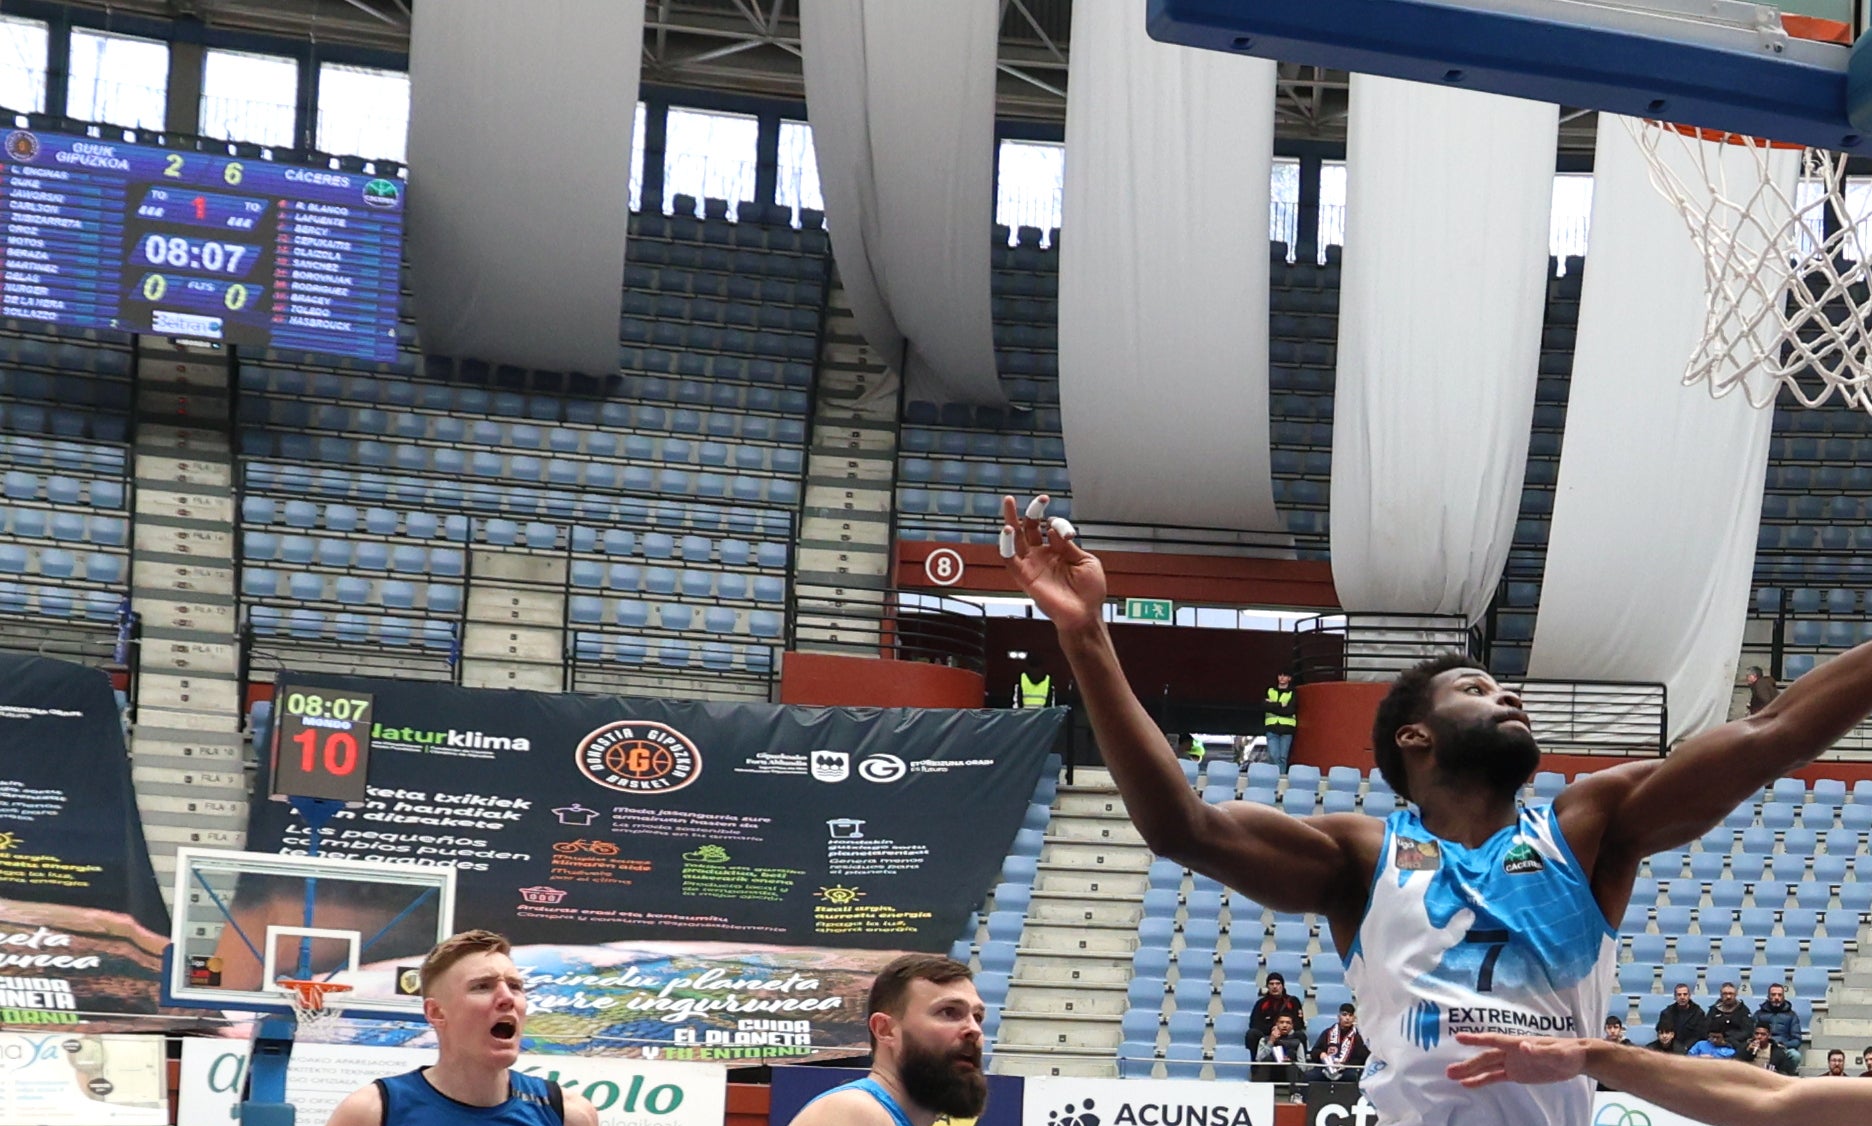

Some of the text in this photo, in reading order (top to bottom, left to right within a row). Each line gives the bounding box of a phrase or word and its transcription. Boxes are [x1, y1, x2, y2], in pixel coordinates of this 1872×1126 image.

[55, 151, 130, 171] GIPUZKOA
[163, 153, 244, 186] 2 6
[191, 195, 207, 219] 1
[145, 234, 246, 273] 08:07
[143, 274, 247, 311] 0 0
[936, 558, 952, 576] 8
[287, 692, 370, 722] 08:07
[293, 727, 360, 776] 10
[586, 727, 634, 772] DONOSTIA
[605, 774, 671, 789] BASKET
[393, 801, 522, 821] handiak
[433, 788, 532, 811] txikiek
[363, 811, 504, 830] ditzakete
[341, 829, 489, 848] pequeños
[364, 853, 490, 872] grandes
[416, 844, 531, 862] pueden
[1464, 930, 1510, 992] 7
[661, 968, 820, 998] planeta
[627, 992, 843, 1023] ingurunea
[738, 1019, 811, 1033] CUIDA
[1448, 1007, 1577, 1032] EXTREMADUR
[674, 1028, 811, 1046] EL PLANETA
[665, 1046, 698, 1060] TU
